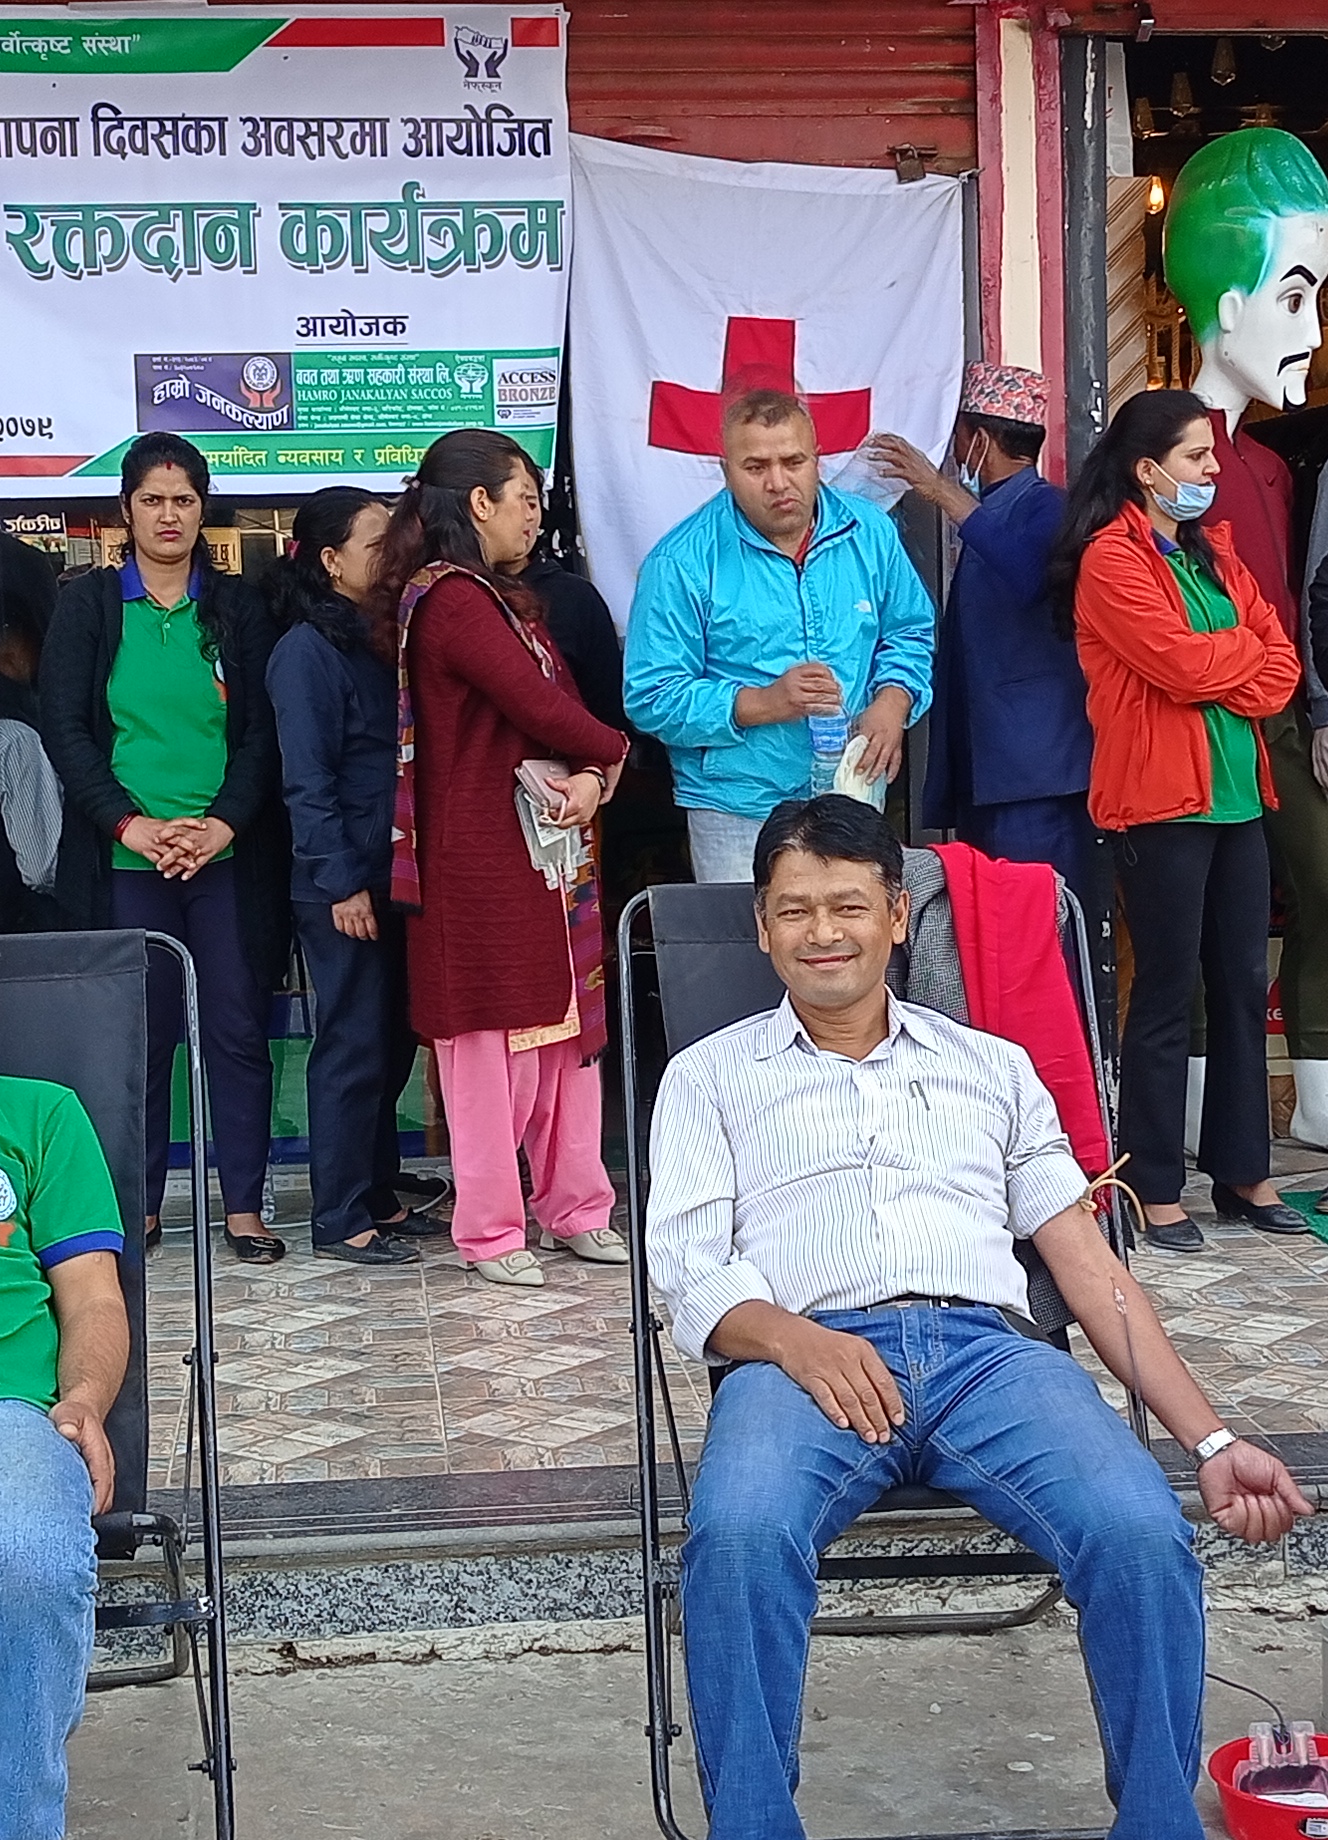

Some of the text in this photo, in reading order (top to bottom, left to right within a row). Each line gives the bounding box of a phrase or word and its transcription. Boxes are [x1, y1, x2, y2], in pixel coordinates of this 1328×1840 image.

[92, 102, 228, 161] दिवसका
[241, 114, 389, 160] अवसरमा
[403, 105, 553, 160] आयोजित
[4, 201, 261, 281] रक्तदान
[296, 308, 409, 338] आयोजक
[296, 368, 318, 386] बचत
[320, 368, 339, 385] तथा
[367, 363, 406, 386] सहकारी
[407, 364, 435, 386] संस्था
[498, 369, 556, 385] ACCESS
[151, 374, 290, 430] हाम्रो जनकल्याण
[297, 388, 453, 403] HAMRO JANAKALYAN SACCOS
[498, 386, 556, 402] BRONZE
